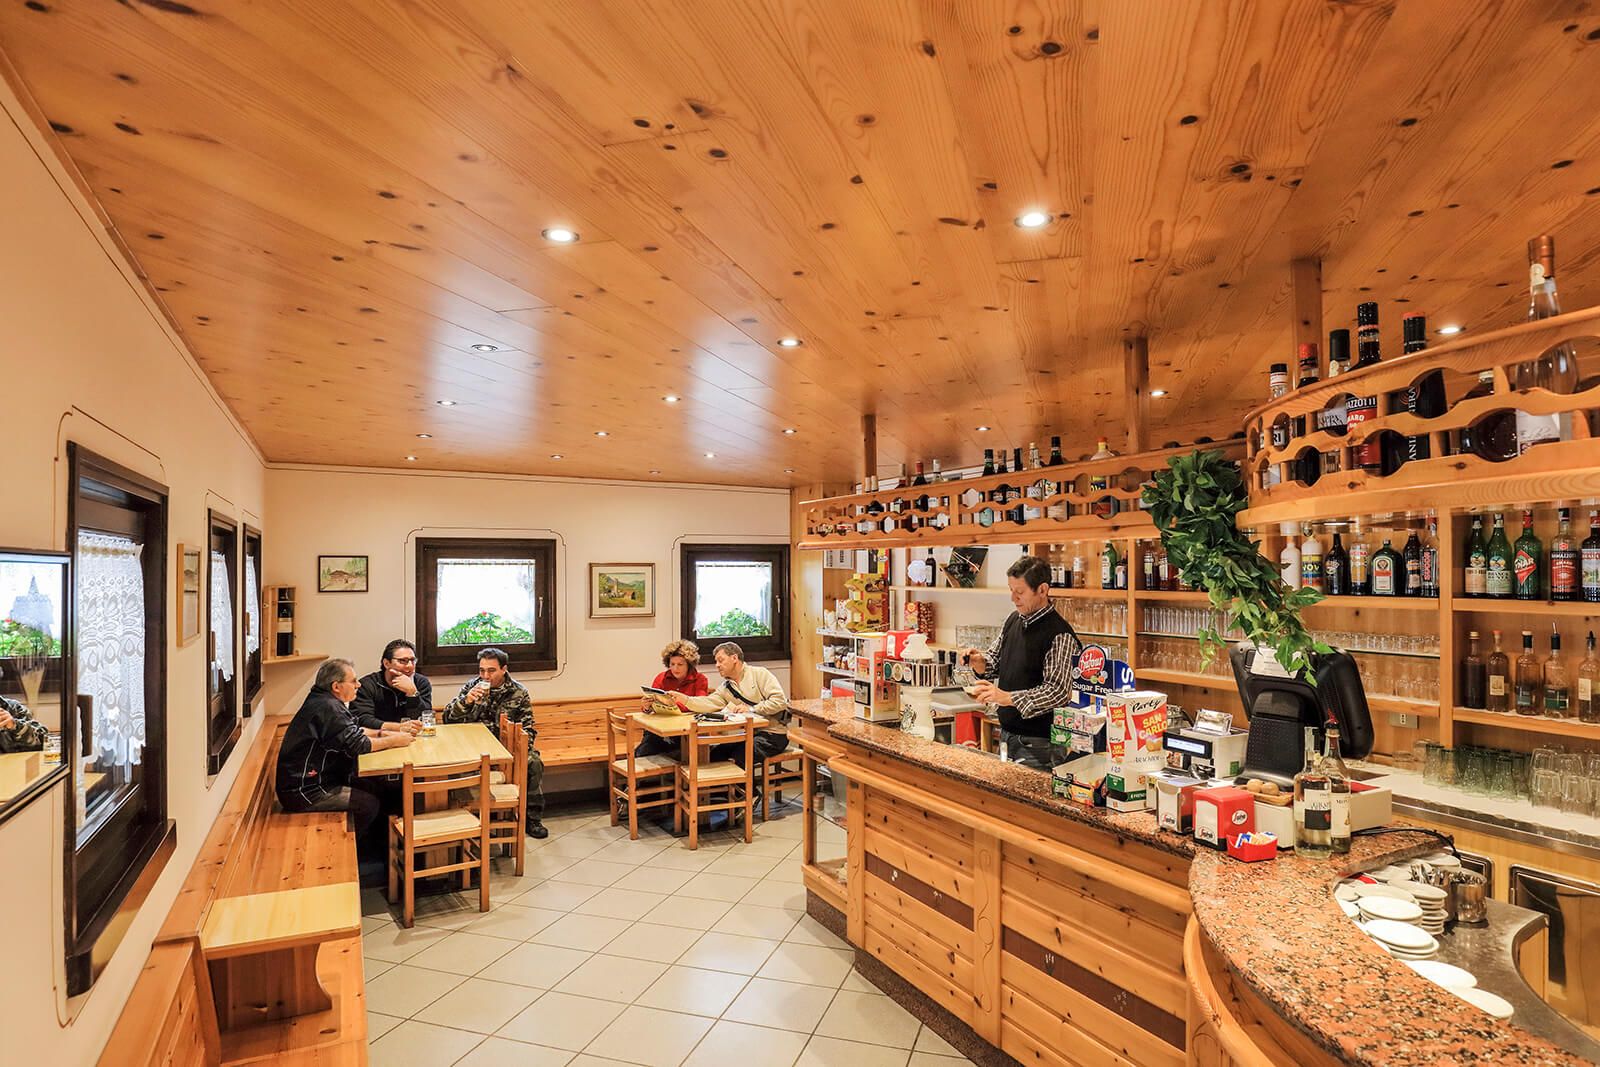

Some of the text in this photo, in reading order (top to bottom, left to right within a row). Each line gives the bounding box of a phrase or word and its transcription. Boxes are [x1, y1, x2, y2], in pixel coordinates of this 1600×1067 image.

[1072, 681, 1093, 693] Sugar
[1132, 700, 1161, 713] Party
[1142, 713, 1162, 728] SAN
[1139, 720, 1168, 739] CARLO
